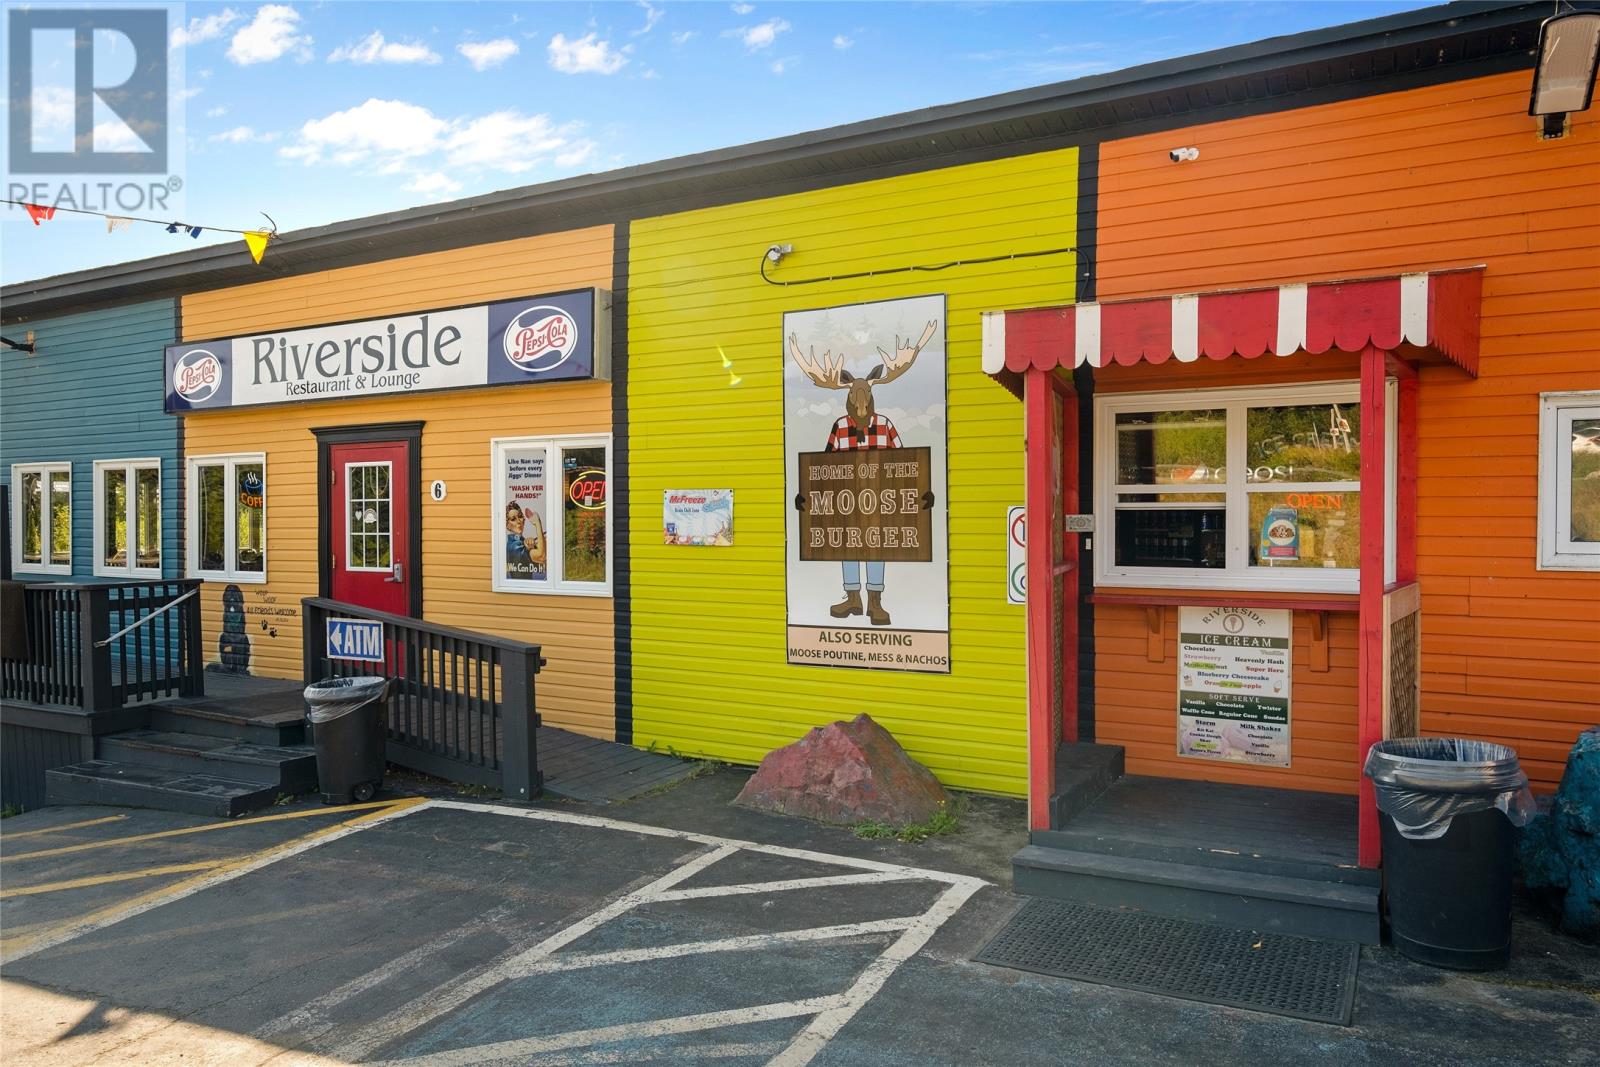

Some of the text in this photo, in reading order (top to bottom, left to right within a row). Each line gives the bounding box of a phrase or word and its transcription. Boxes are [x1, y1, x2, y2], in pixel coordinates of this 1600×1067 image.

[251, 315, 462, 385] Riverside
[286, 373, 421, 396] Restaurant & Lounge
[809, 462, 919, 480] HOME OF THE
[434, 483, 442, 499] 6
[810, 489, 919, 515] MOOSE
[1286, 493, 1342, 510] OPEN
[810, 527, 919, 548] BURGER
[517, 563, 529, 573] Can
[529, 563, 537, 573] Do
[1202, 607, 1266, 627] RIVERSIDE
[344, 625, 379, 656] ATM
[818, 631, 913, 646] ALSO SERVING
[1200, 634, 1272, 647] ICE CREAM
[789, 648, 947, 666] MOOSE POUTINE, MESS & NACHOS
[1197, 671, 1270, 681] Blueberry Cheesecake
[1232, 695, 1261, 703] SERVE
[1219, 710, 1242, 718] Regular
